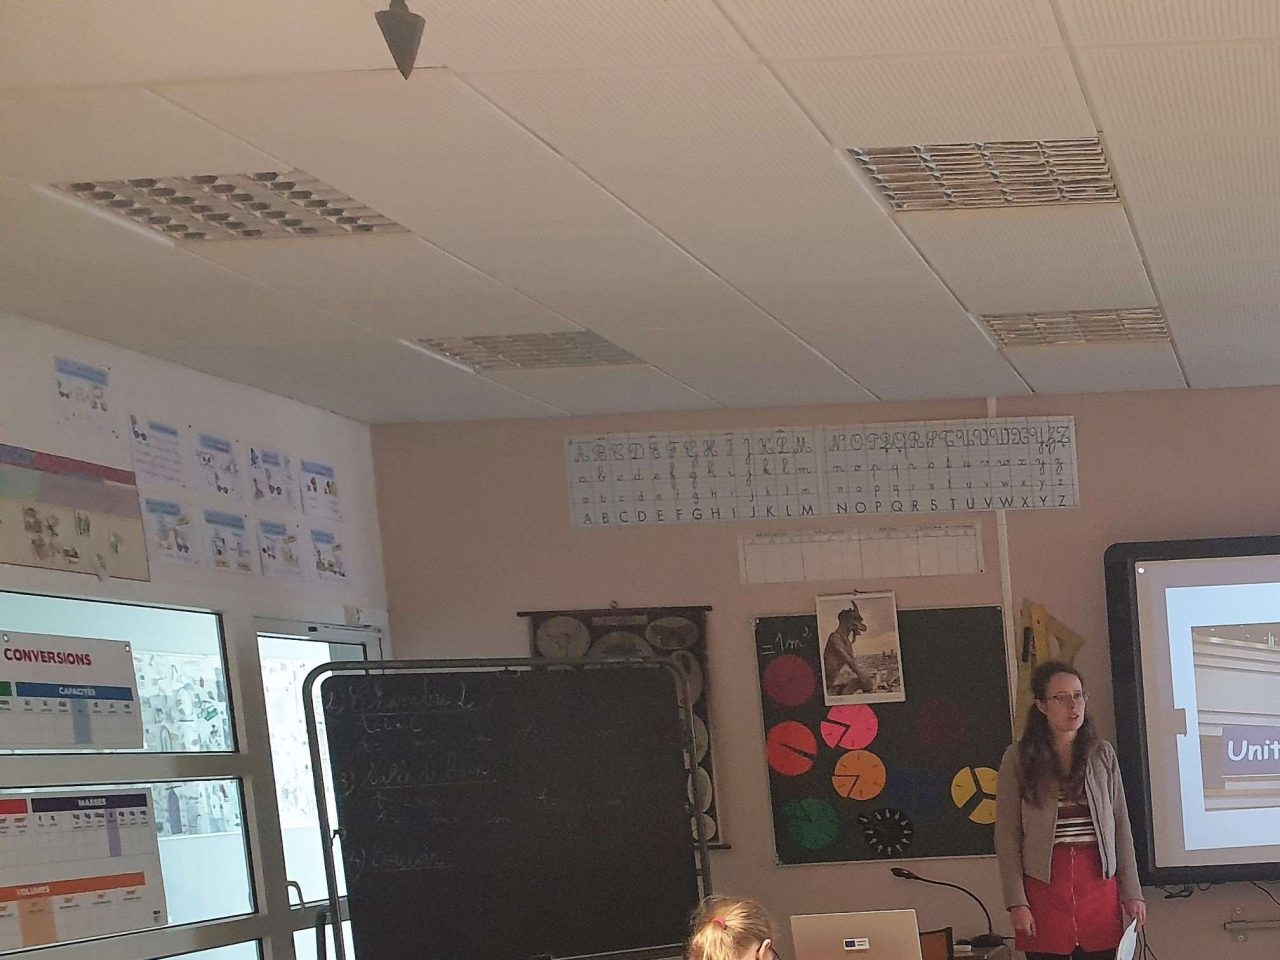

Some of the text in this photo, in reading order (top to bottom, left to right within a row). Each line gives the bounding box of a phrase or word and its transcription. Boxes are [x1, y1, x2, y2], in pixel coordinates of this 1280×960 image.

[584, 513, 592, 524] A
[602, 512, 609, 524] B
[619, 511, 629, 523] C
[637, 511, 647, 522] D
[657, 510, 664, 521] E
[676, 509, 682, 520] F
[692, 508, 703, 520] G
[711, 507, 720, 519] H
[750, 506, 755, 518] J
[766, 506, 775, 517] K
[801, 505, 814, 516] M
[837, 502, 847, 514] N
[855, 502, 866, 513] O
[875, 501, 882, 512] P
[891, 500, 903, 512] Q
[911, 500, 919, 512] R
[930, 499, 938, 511] S
[950, 498, 956, 510] T
[967, 497, 975, 509] U
[984, 497, 992, 508] V
[999, 496, 1013, 507] W
[1021, 497, 1029, 508] X
[1039, 496, 1048, 506] Y
[1059, 495, 1066, 506] Z
[3, 647, 93, 666] CONVERSIONS
